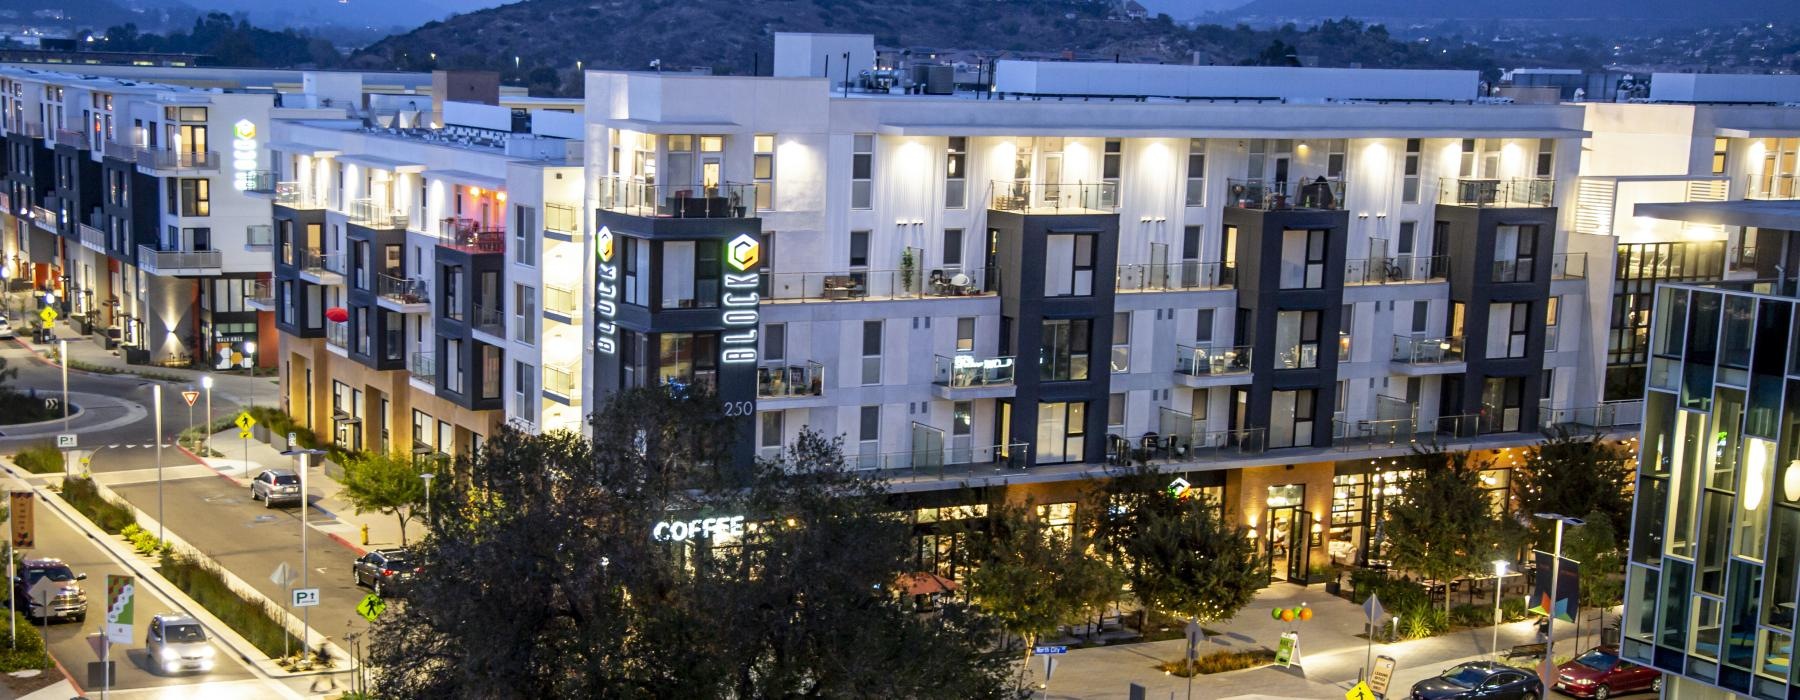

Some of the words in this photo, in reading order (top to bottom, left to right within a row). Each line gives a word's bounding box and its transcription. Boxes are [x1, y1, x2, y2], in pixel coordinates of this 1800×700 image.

[722, 273, 760, 363] BLOCK
[724, 401, 753, 416] 250
[60, 436, 69, 446] P
[653, 516, 745, 542] COFFEE
[296, 592, 308, 605] P
